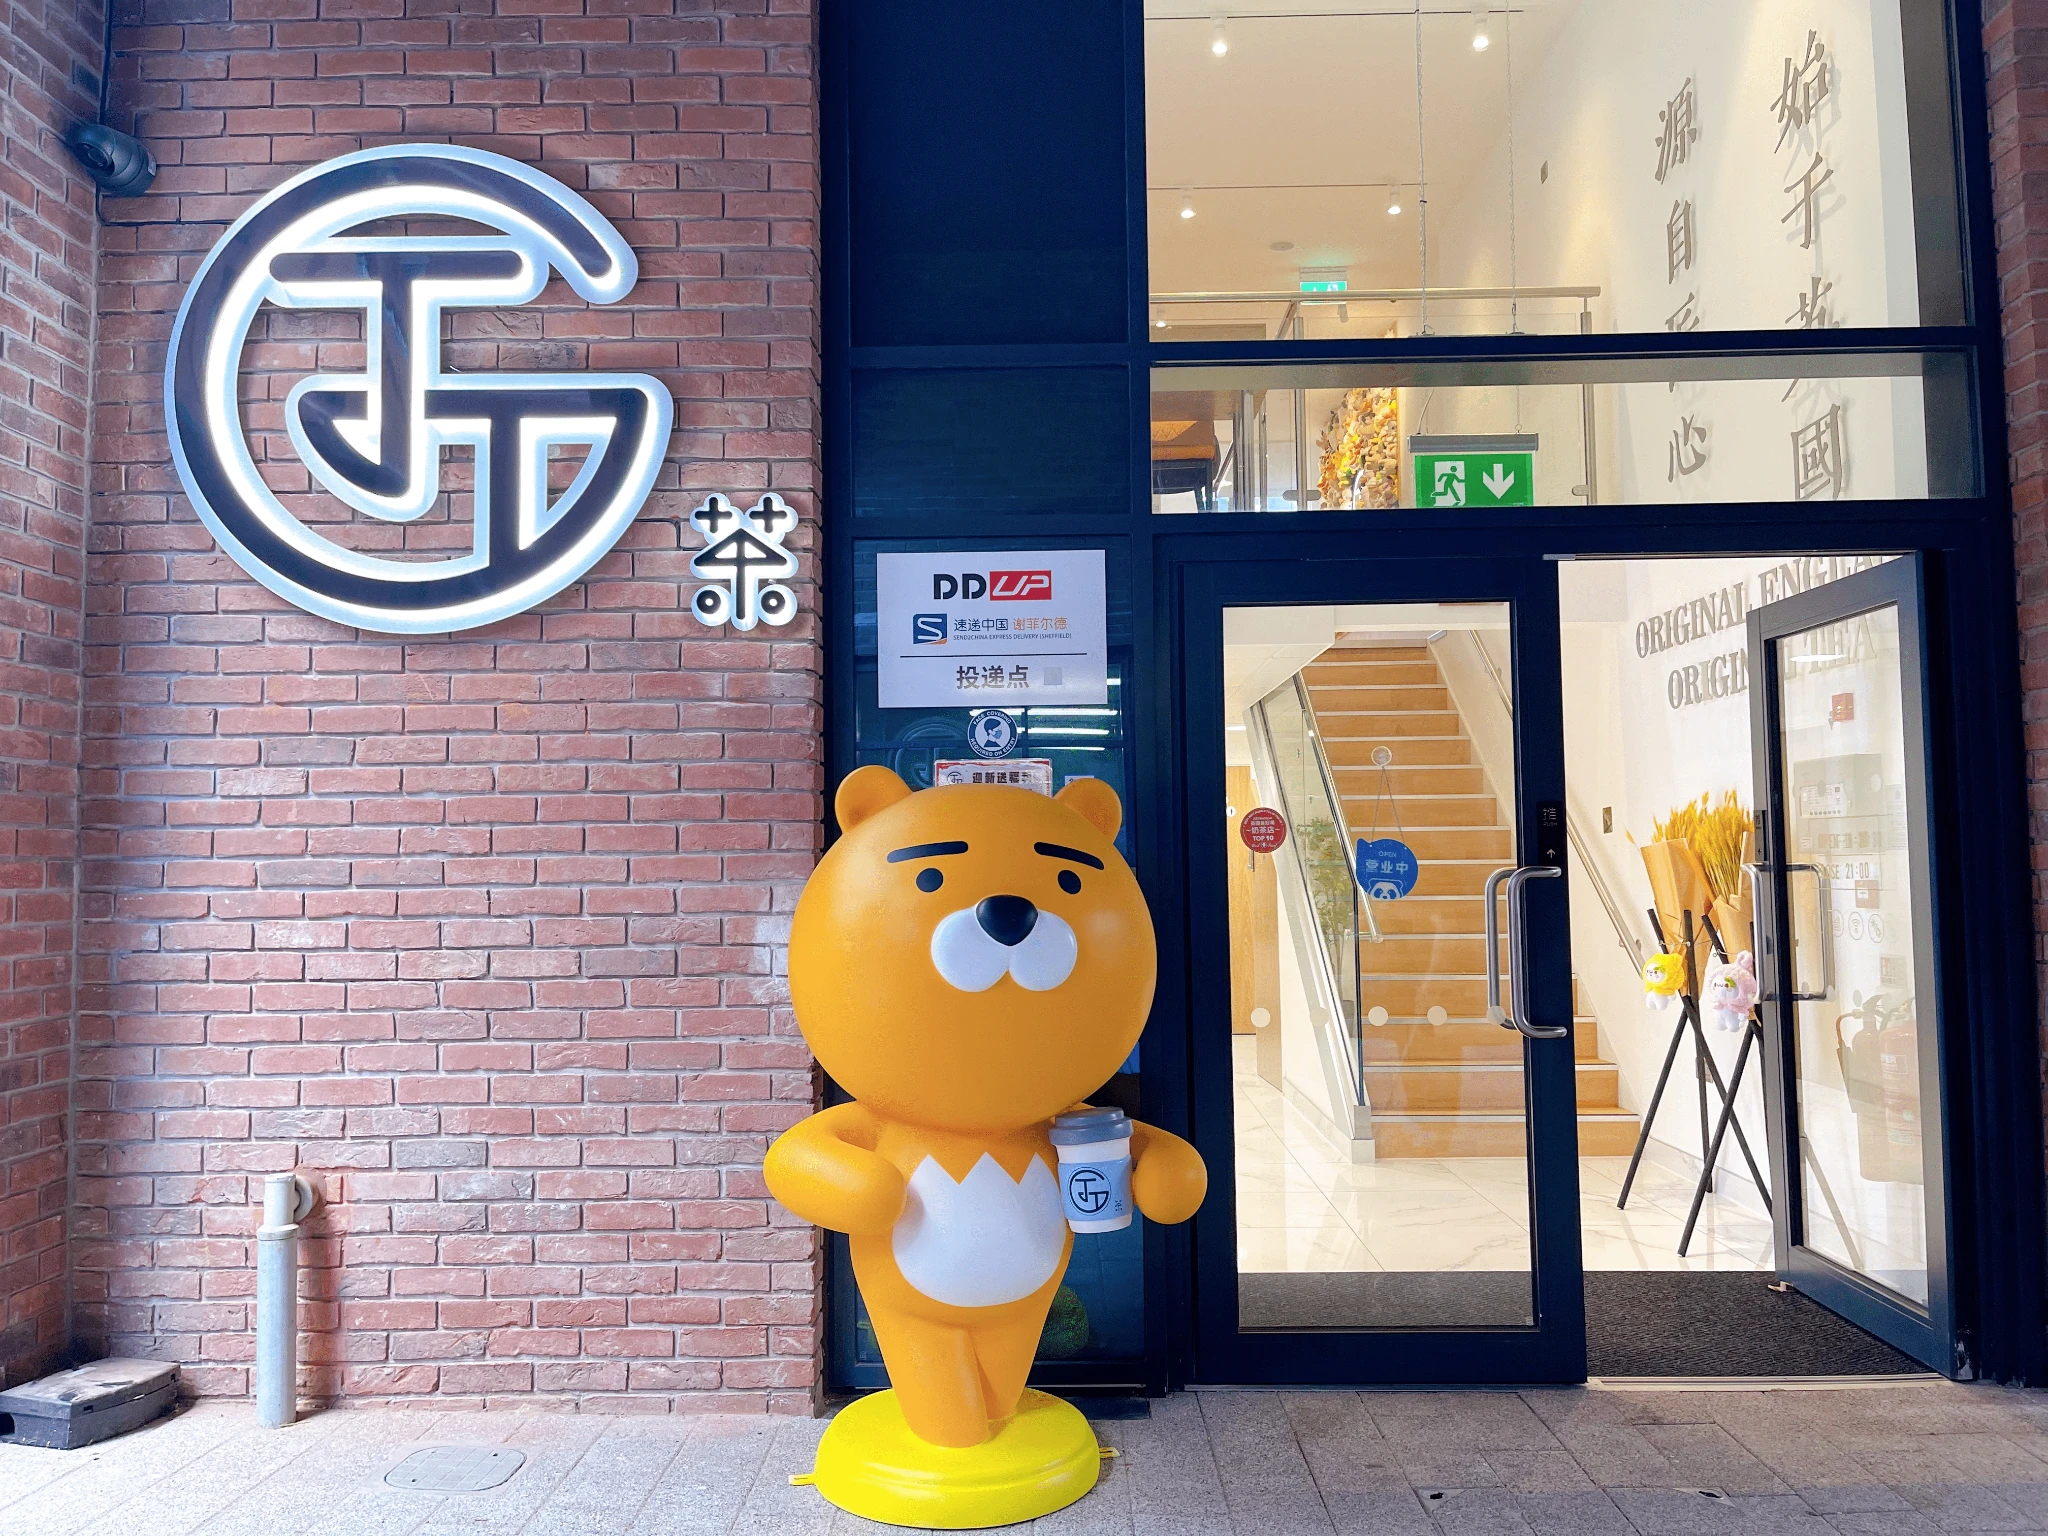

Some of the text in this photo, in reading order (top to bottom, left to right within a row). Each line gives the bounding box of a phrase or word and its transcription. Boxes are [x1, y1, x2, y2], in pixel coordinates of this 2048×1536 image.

[953, 617, 1068, 632] 速递中国 谢菲尔德
[1636, 582, 1752, 658] ORIGINAL
[956, 664, 1030, 690] 投递点
[972, 714, 986, 726] FACE
[969, 737, 994, 757] REQUIRED
[1002, 737, 1016, 753] ENTRY
[1378, 850, 1397, 858] OPEN
[1365, 859, 1409, 875] 营业中
[1845, 861, 1869, 880] 21:00
